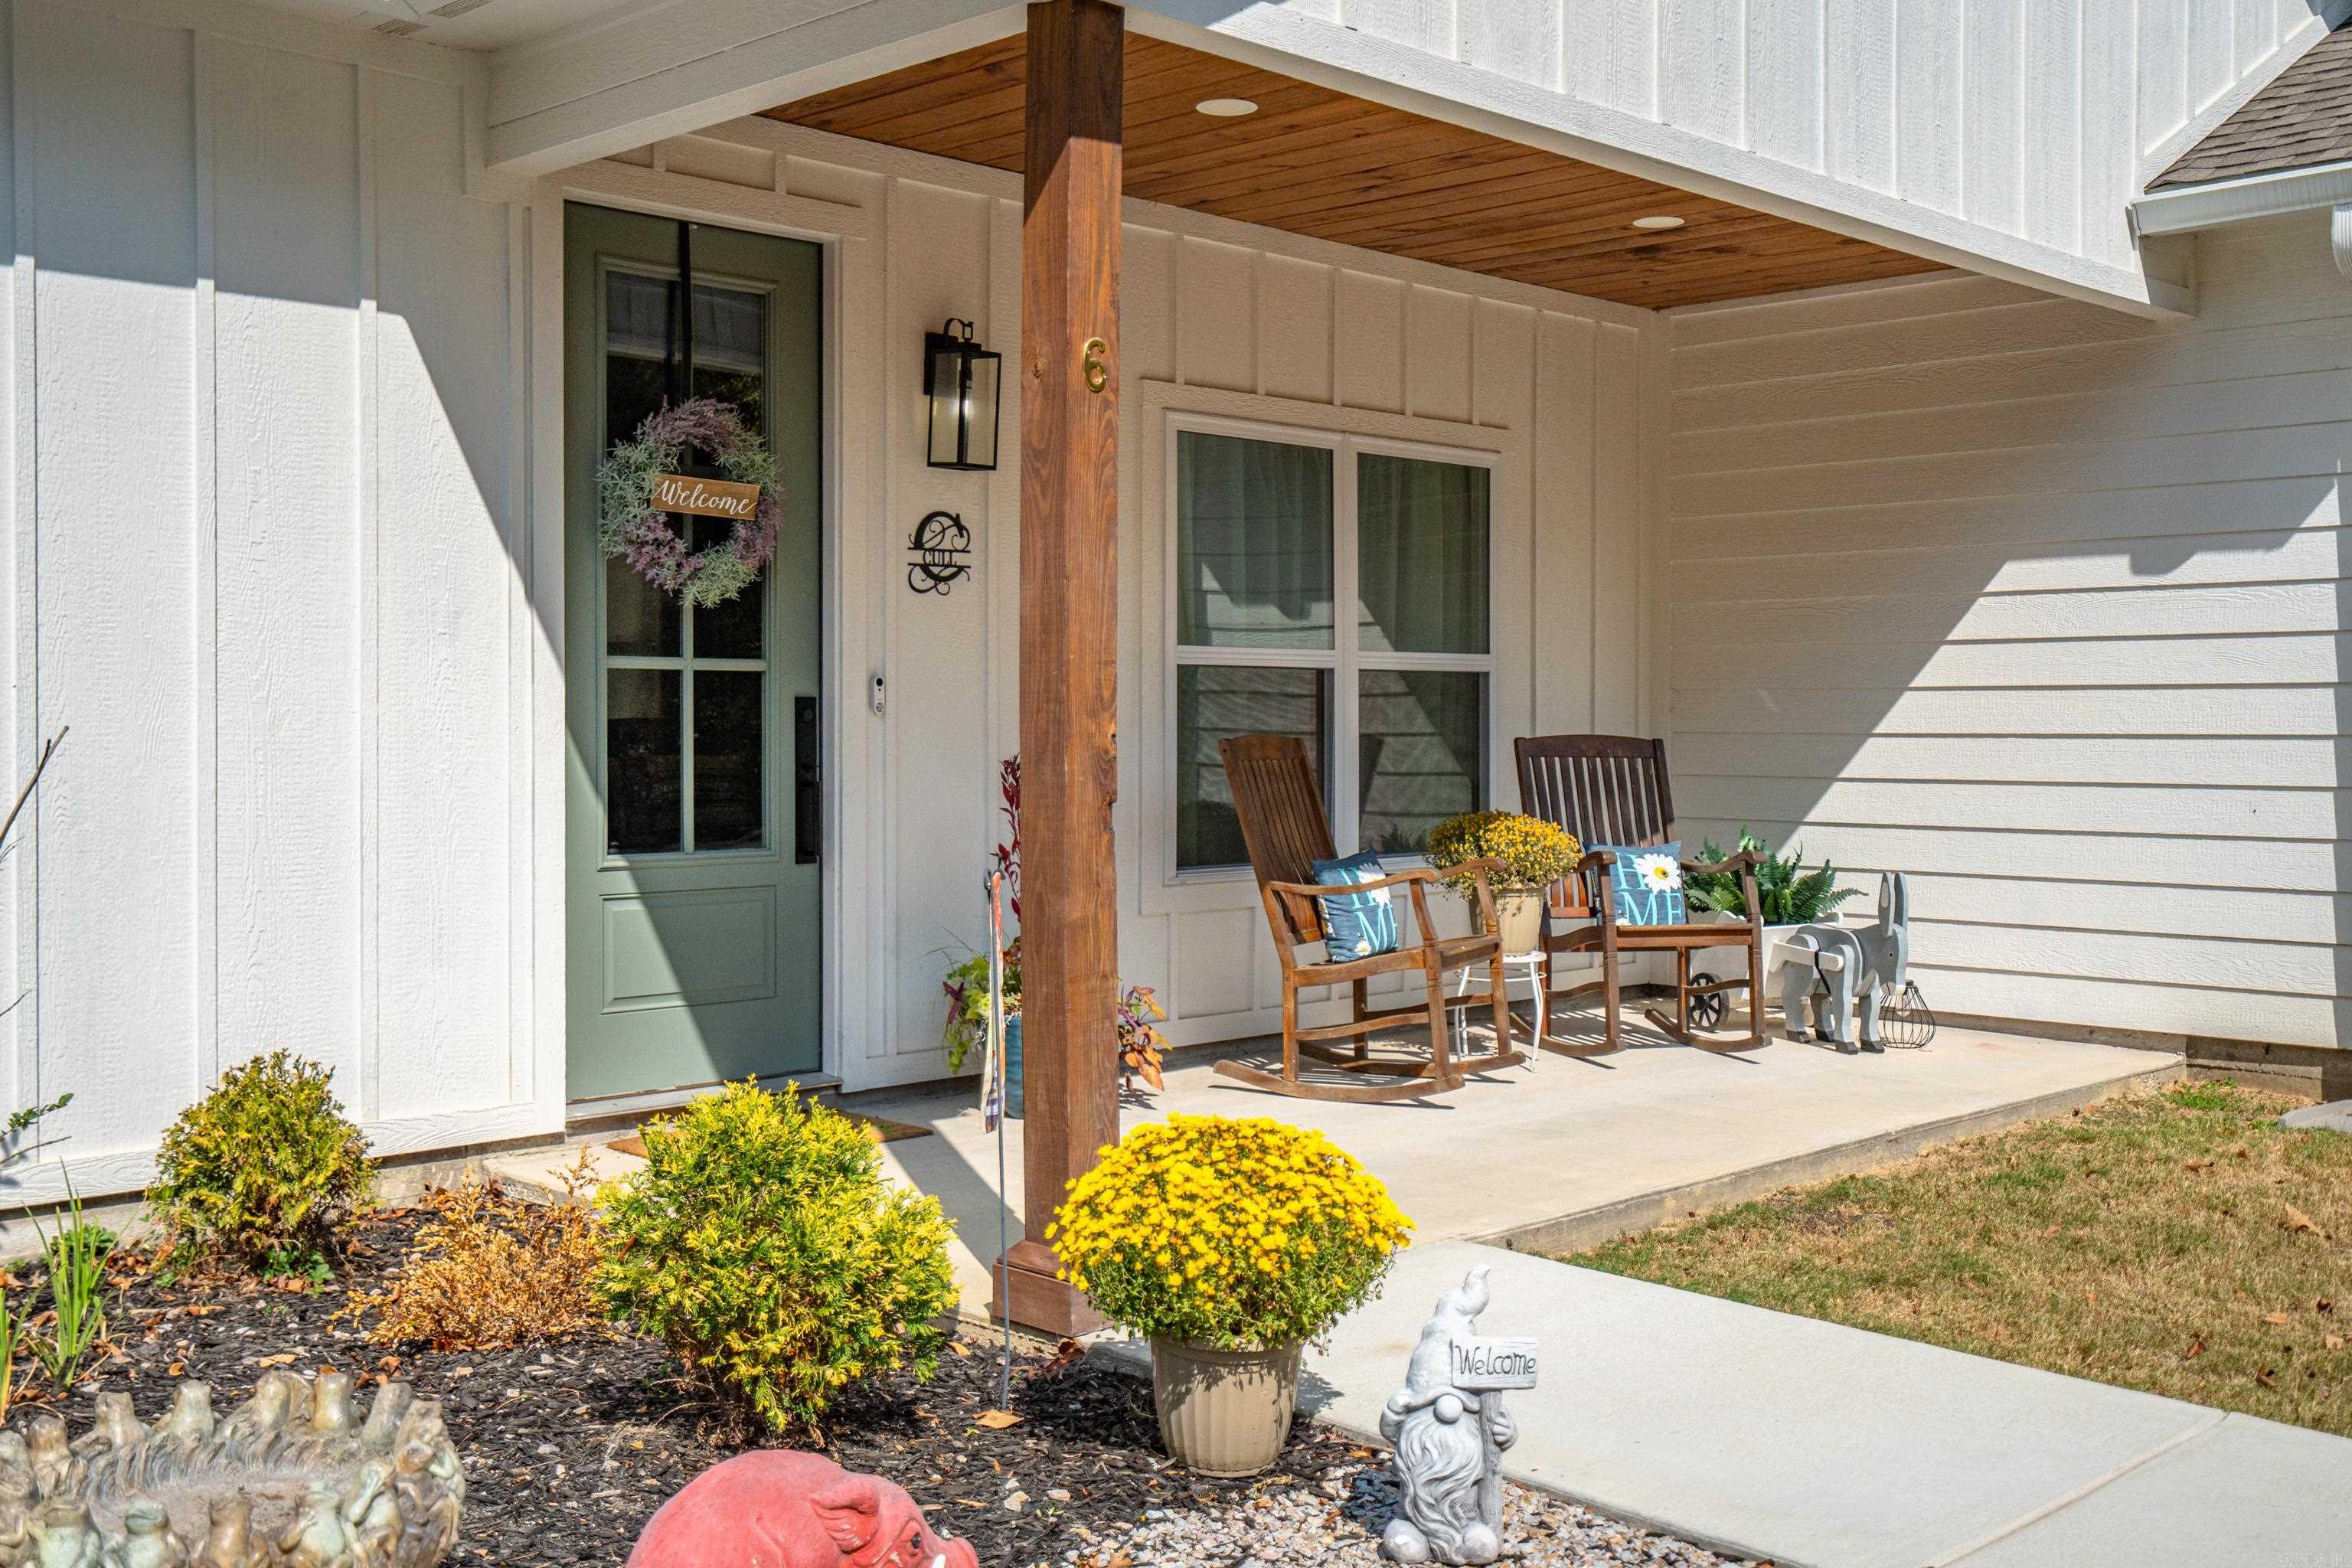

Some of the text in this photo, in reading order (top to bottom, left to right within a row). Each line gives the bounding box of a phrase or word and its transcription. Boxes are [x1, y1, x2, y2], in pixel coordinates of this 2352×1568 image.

[1083, 337, 1107, 393] 6
[651, 480, 758, 515] Welcome
[1454, 1345, 1537, 1375] Welcome
